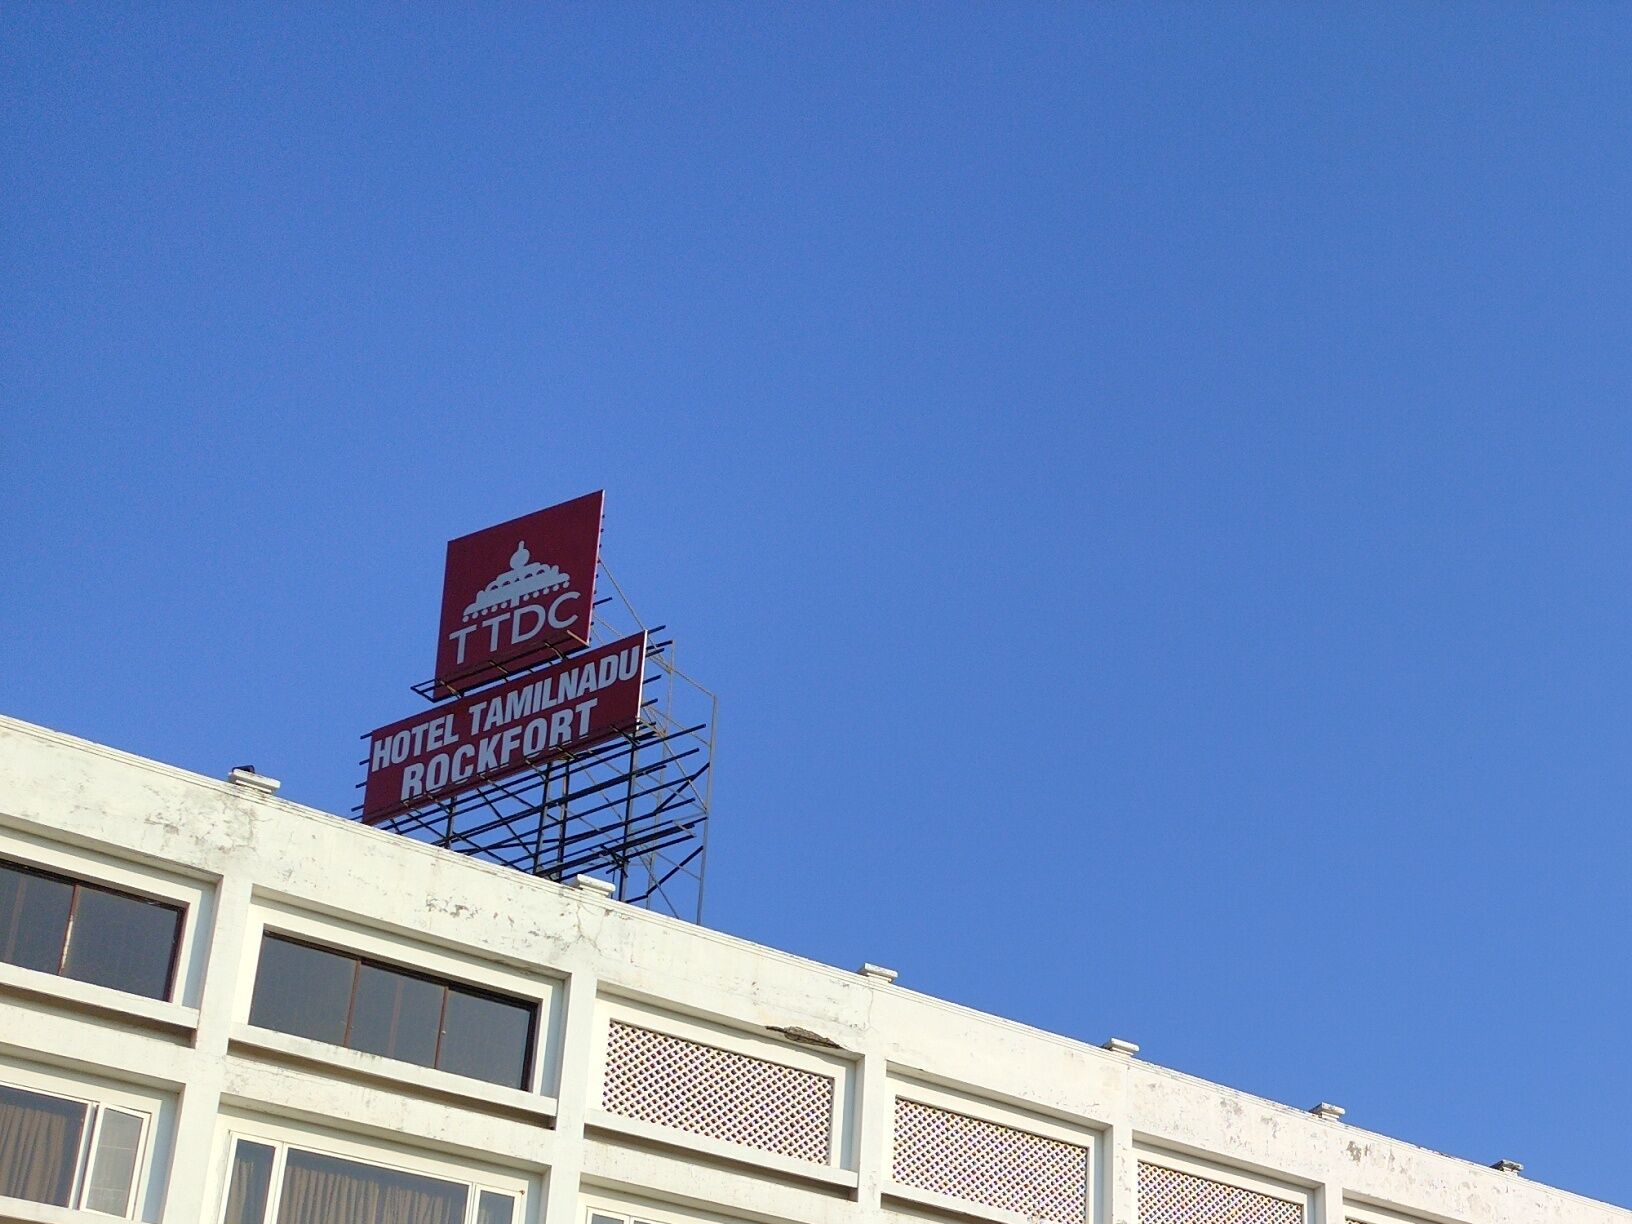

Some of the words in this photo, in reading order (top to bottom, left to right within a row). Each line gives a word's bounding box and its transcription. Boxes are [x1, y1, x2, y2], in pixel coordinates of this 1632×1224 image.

[449, 592, 581, 664] TTDC
[371, 714, 459, 772] HOTEL
[468, 645, 641, 731] TAMILNADU
[400, 698, 600, 802] ROCKFORT
